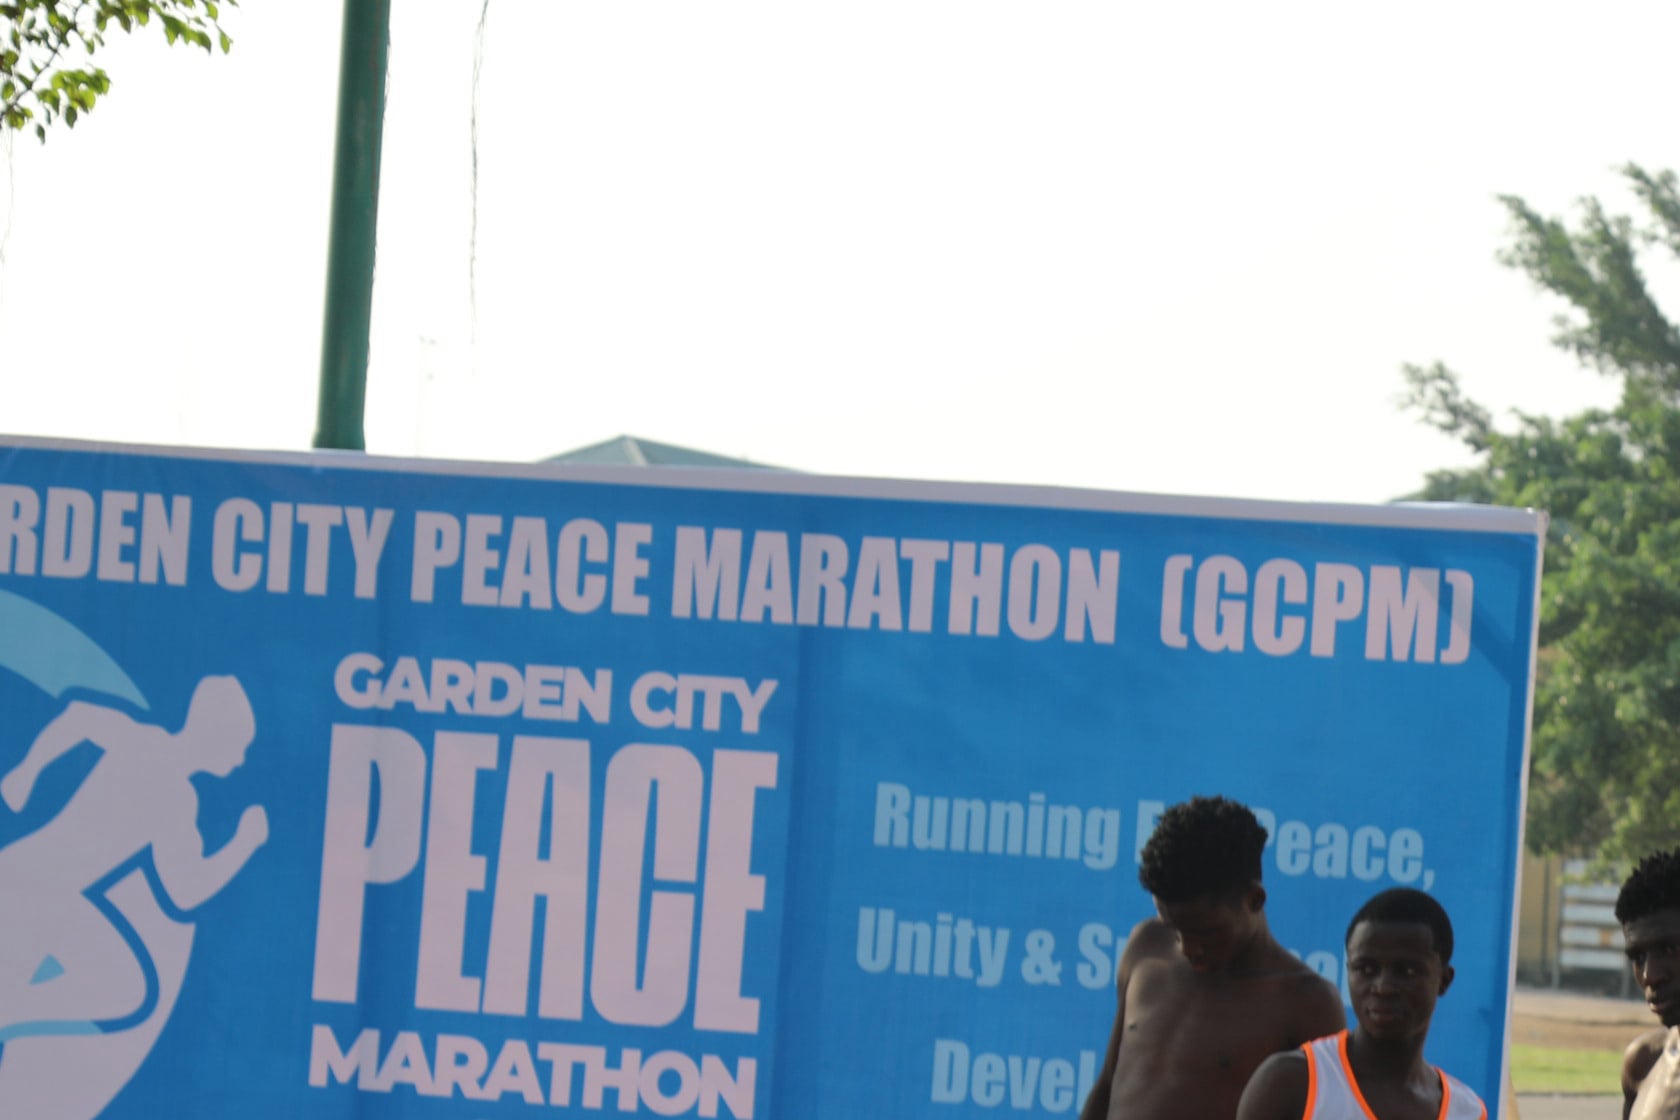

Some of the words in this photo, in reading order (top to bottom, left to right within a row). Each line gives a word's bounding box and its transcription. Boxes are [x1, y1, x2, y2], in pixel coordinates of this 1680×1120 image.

[211, 497, 395, 600] CITY
[410, 510, 653, 615] PEACE
[671, 525, 1120, 645] MARATHON
[1160, 554, 1474, 665] (GCPM)
[334, 652, 612, 724] GARDEN
[630, 671, 779, 734] CITY
[873, 782, 1120, 870] Running
[311, 722, 779, 1034] PEACE
[856, 907, 1010, 988] Unity
[1021, 928, 1062, 987] &
[309, 1024, 758, 1120] MARATHON
